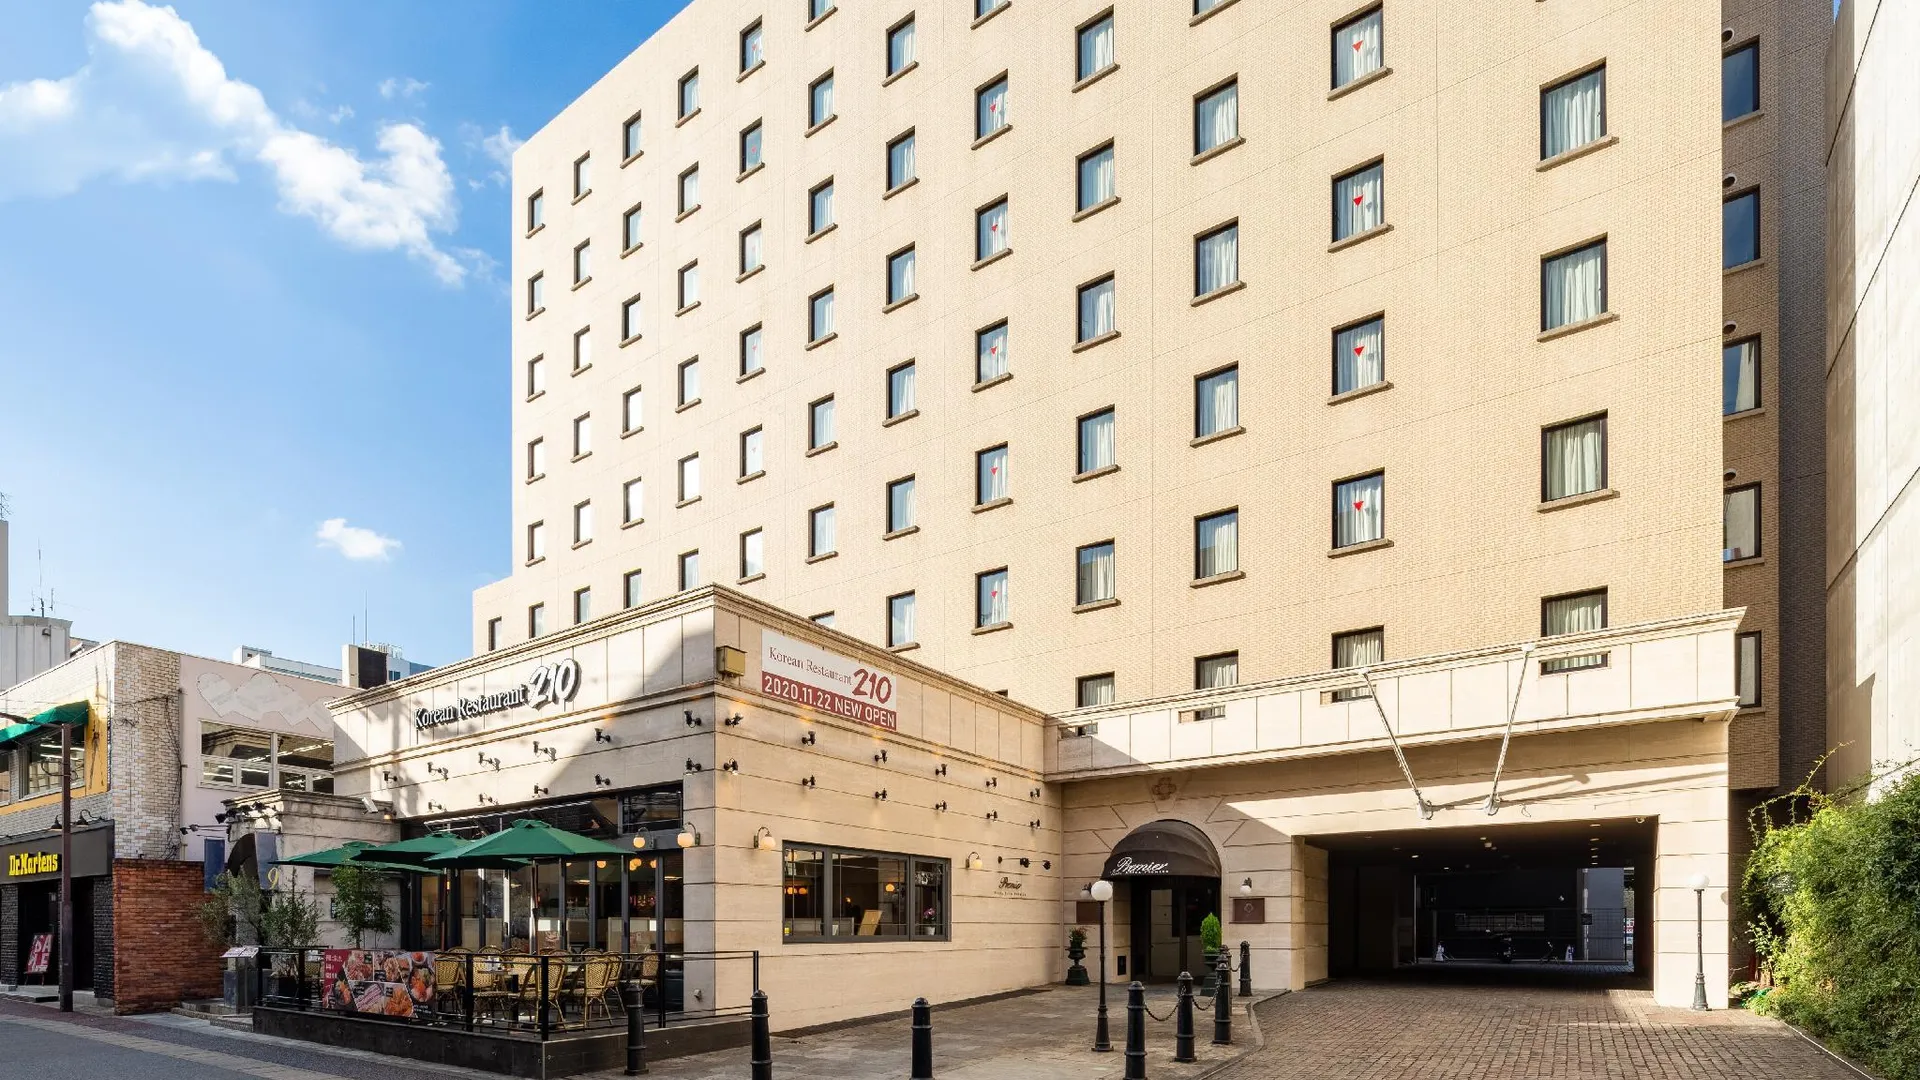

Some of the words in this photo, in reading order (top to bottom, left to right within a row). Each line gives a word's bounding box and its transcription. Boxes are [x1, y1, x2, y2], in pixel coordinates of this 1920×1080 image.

[414, 706, 456, 728] Korean
[457, 684, 525, 718] Restaurant
[529, 658, 577, 707] 210
[764, 675, 832, 710] 2020.11.22
[835, 697, 862, 718] NEW
[865, 706, 895, 728] OPEN
[769, 647, 804, 669] Korean
[805, 659, 852, 685] Restaurant
[852, 669, 892, 704] 210
